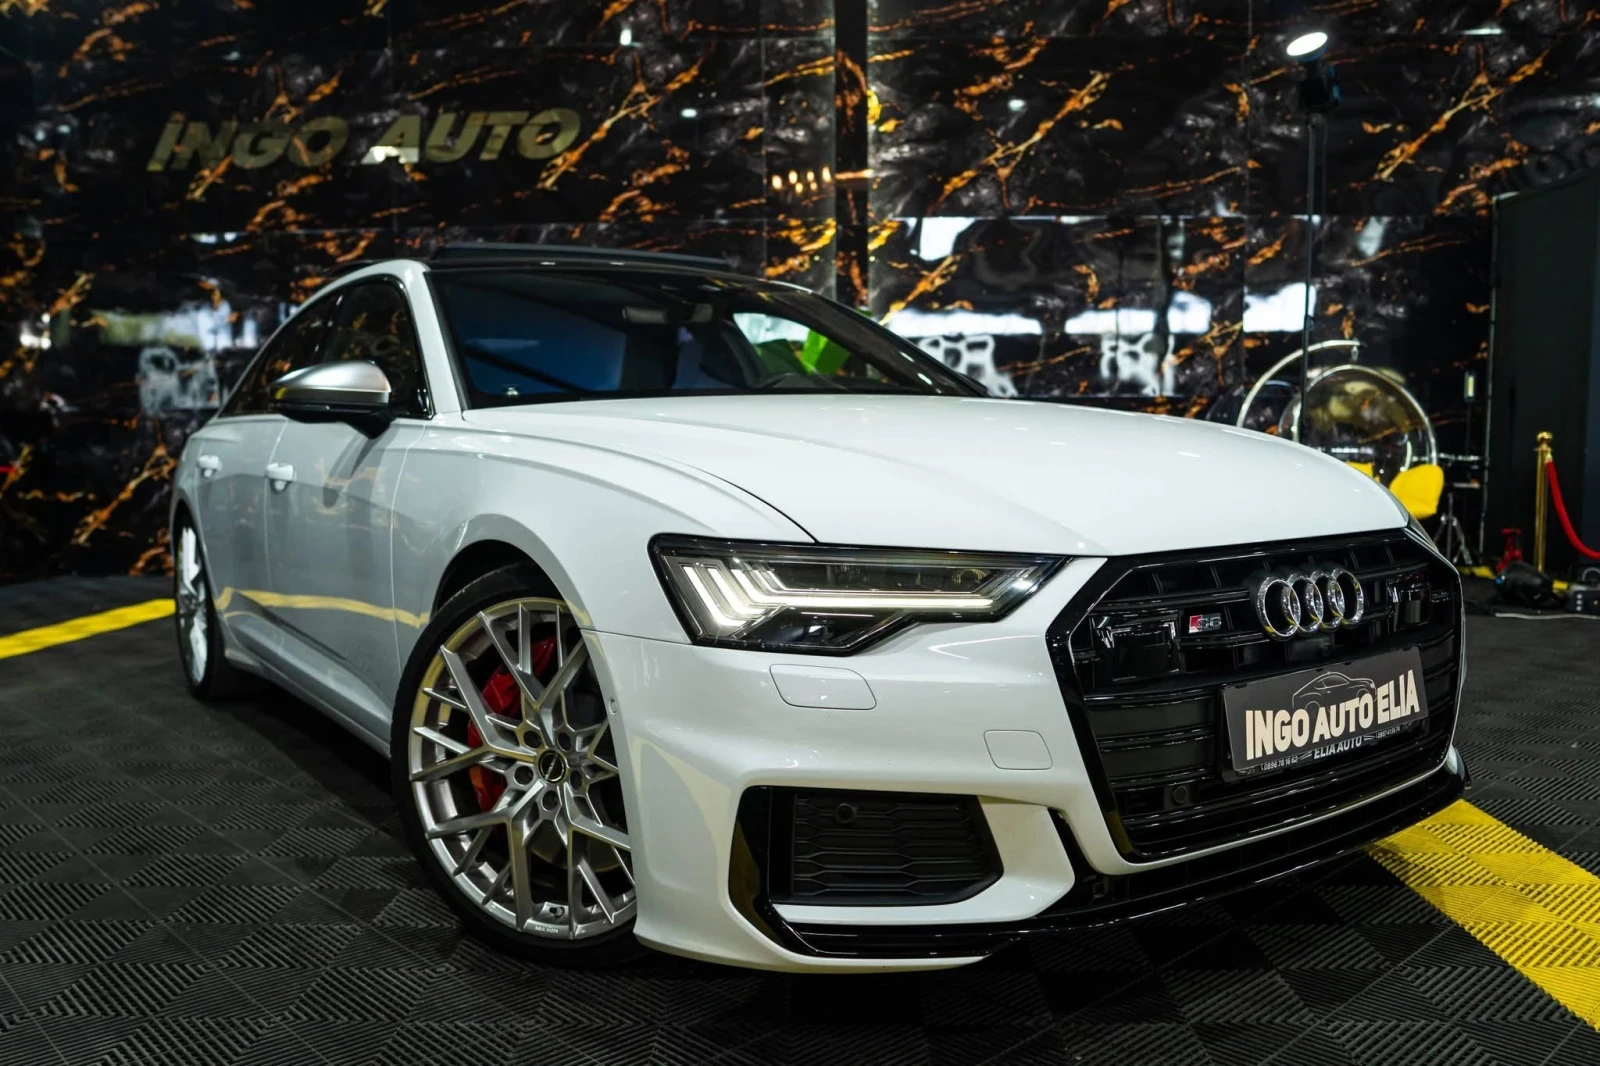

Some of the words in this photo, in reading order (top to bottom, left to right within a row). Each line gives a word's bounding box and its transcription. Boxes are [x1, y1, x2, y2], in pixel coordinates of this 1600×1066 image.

[360, 107, 581, 165] AUTO
[1246, 709, 1310, 760] INGO
[1312, 692, 1374, 744] AUTO
[1377, 669, 1421, 725] ELIA
[1314, 745, 1337, 759] ELIA
[1337, 736, 1362, 752] AUTO
